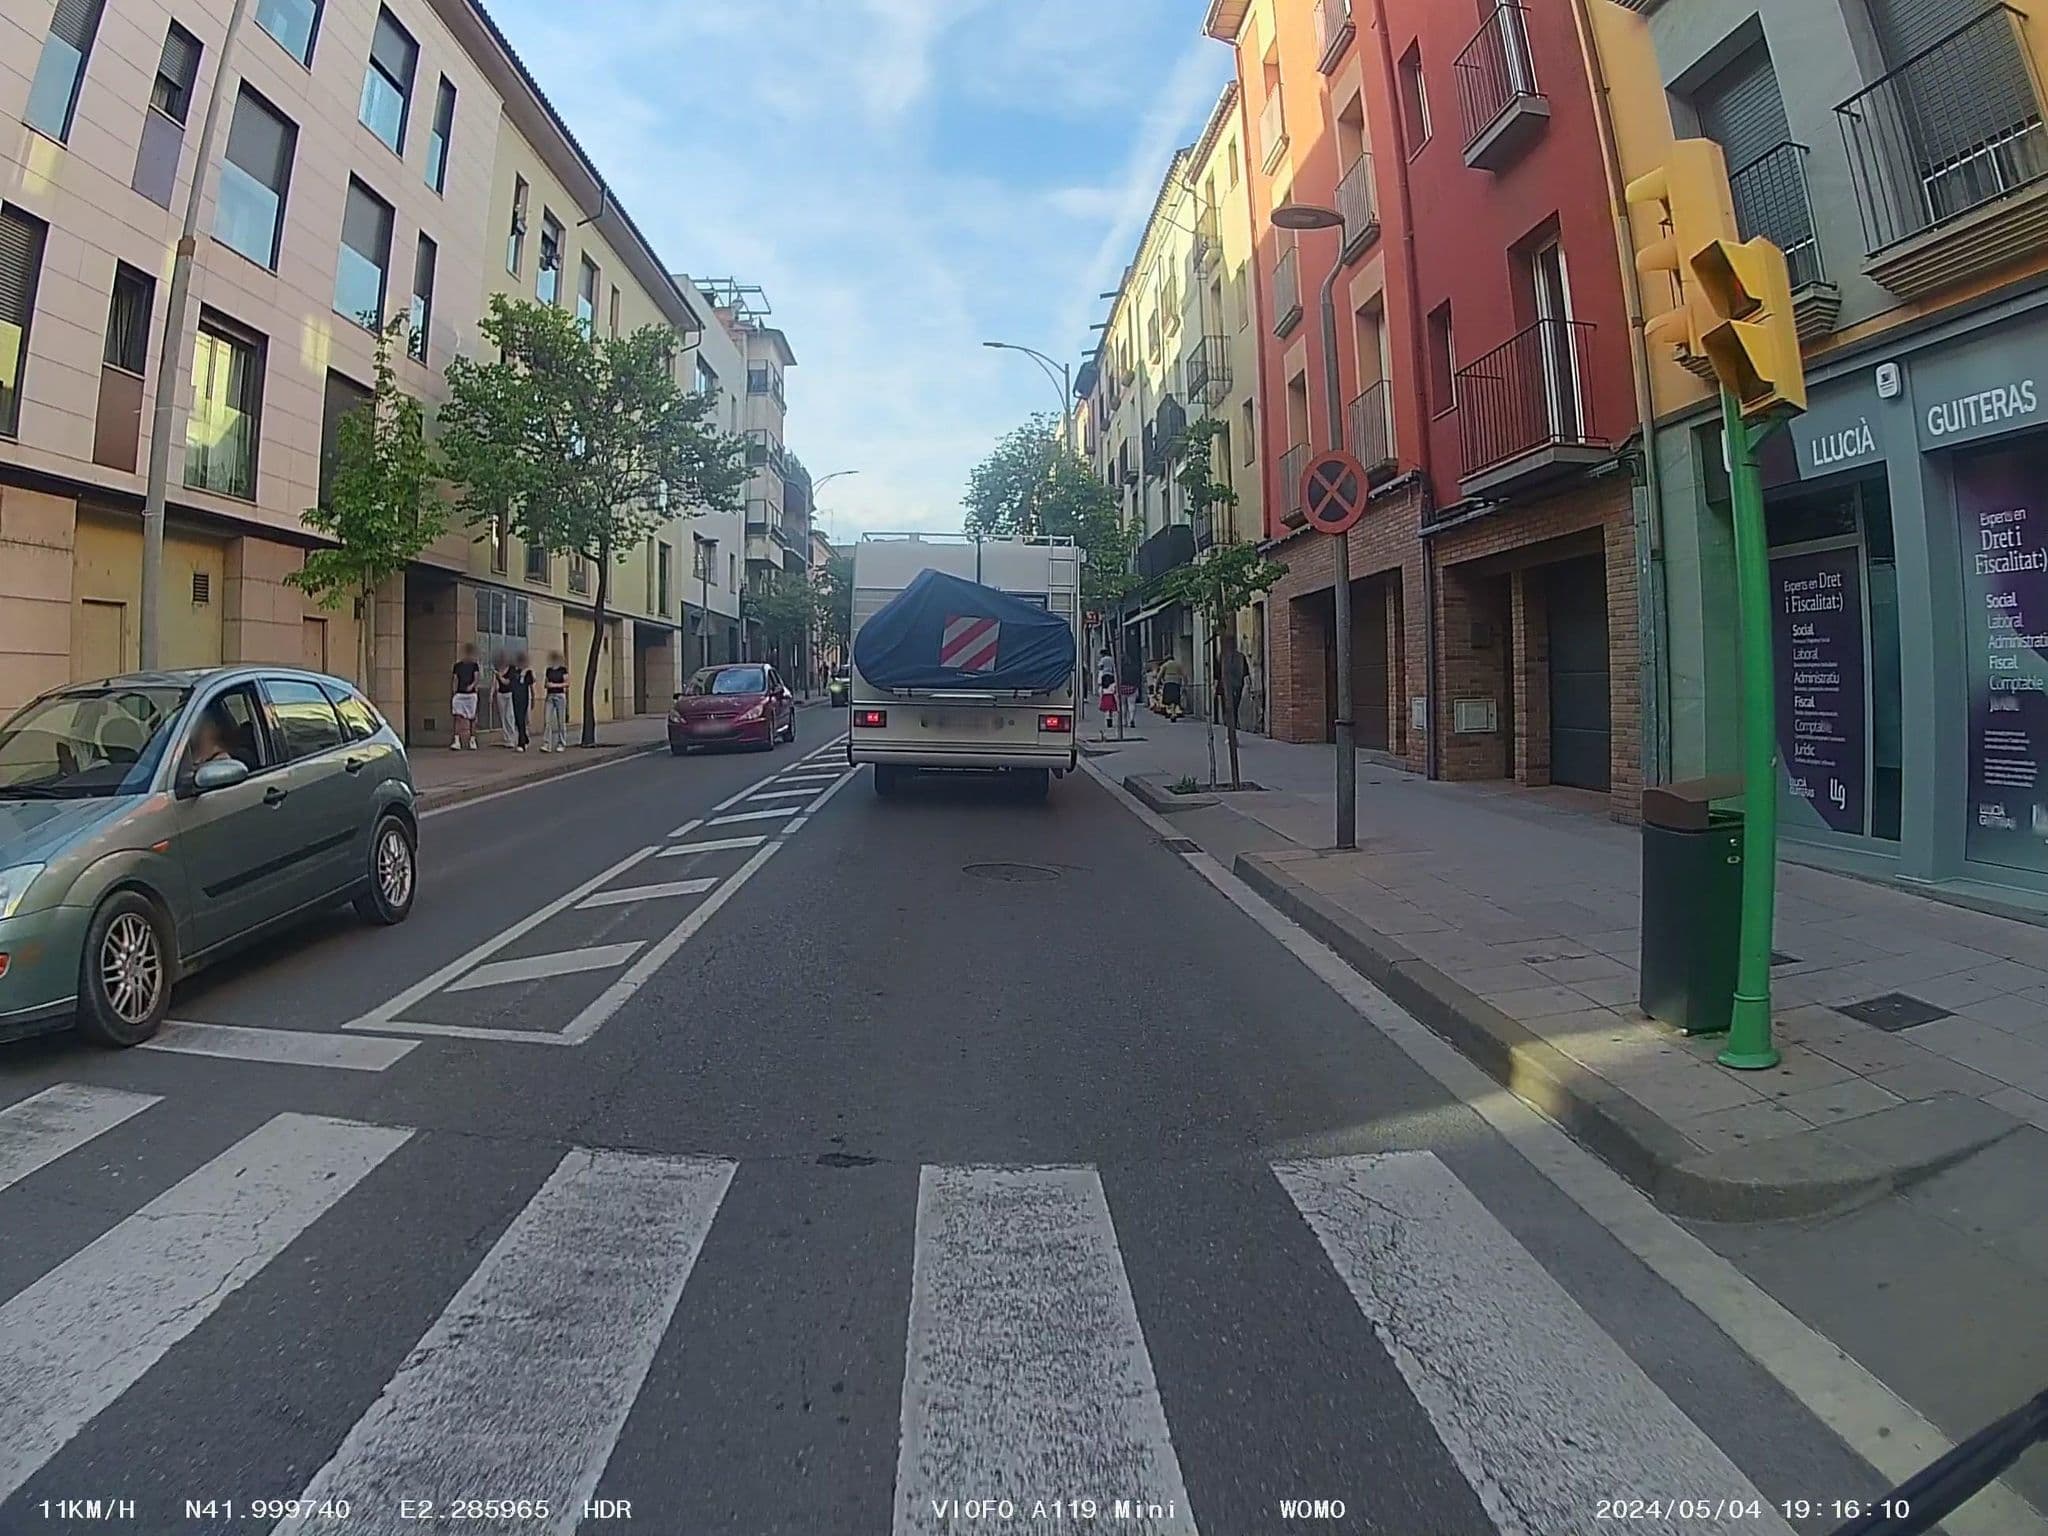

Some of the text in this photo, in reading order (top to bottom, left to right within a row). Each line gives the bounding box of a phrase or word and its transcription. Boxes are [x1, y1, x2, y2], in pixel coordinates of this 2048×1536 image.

[1928, 379, 2038, 436] GUITERAS
[1812, 418, 1876, 466] LLUCIÀ
[1981, 525, 2022, 550] Dret i
[1975, 547, 2047, 575] Fiscalitat:)
[1819, 572, 1841, 589] Dret
[1785, 592, 1843, 613] i Fiscalitat:)
[1986, 592, 2017, 608] Social
[1988, 612, 2024, 629] Laboral
[1792, 623, 1814, 636] Social
[1793, 648, 1818, 660] Laboral
[1989, 655, 2018, 669] Fiscal
[1795, 696, 1815, 707] Fiscal
